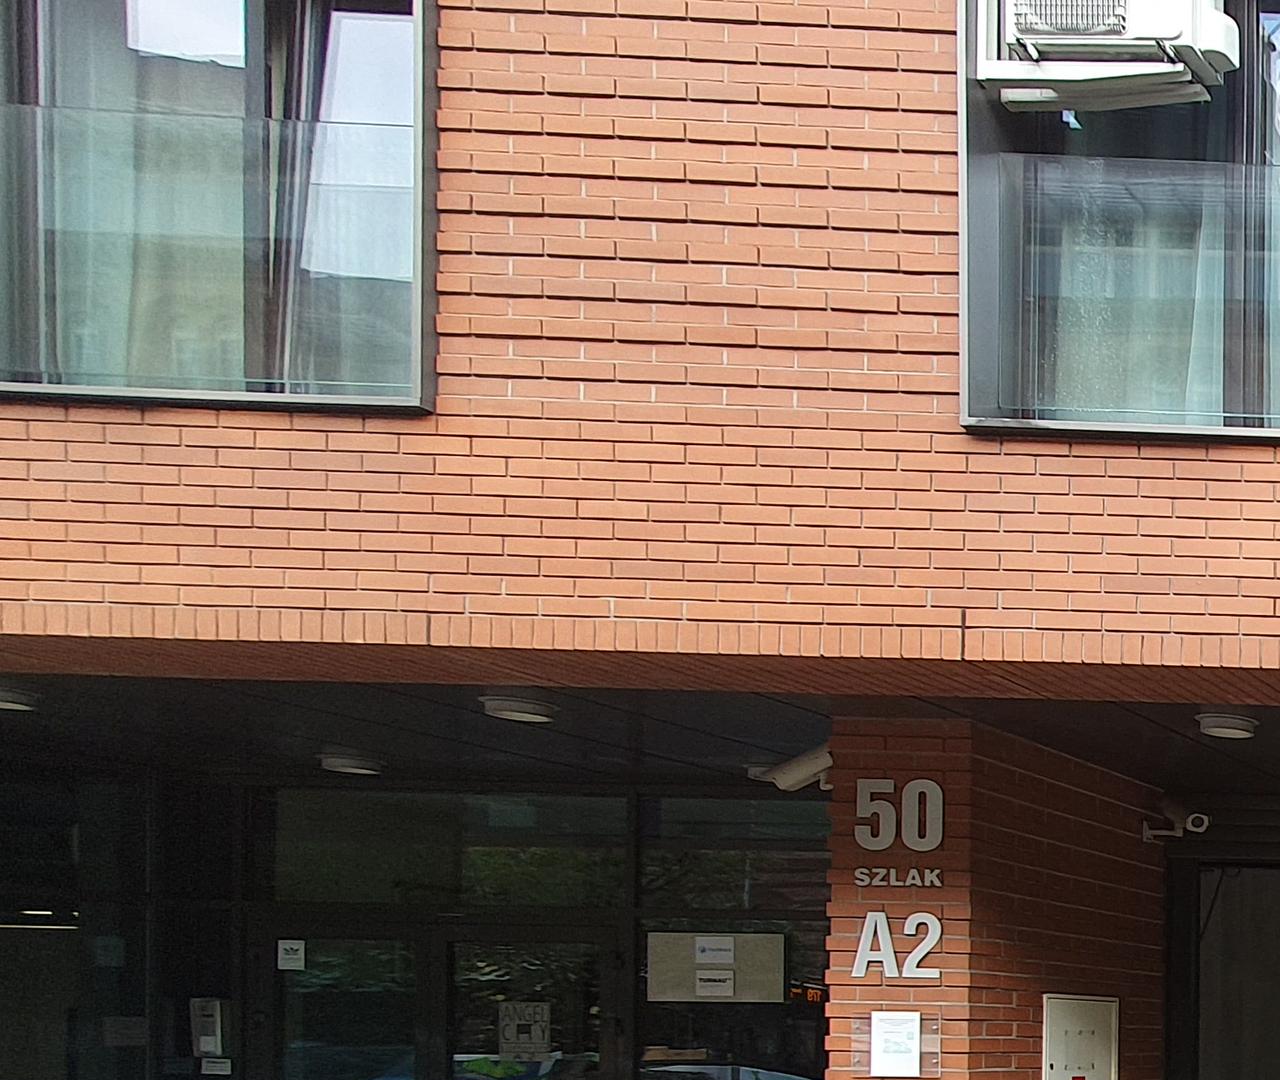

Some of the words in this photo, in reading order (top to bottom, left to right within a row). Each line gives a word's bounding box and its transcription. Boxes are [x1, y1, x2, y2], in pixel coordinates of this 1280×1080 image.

[854, 778, 944, 852] 50
[854, 867, 943, 887] SZLAK
[851, 912, 942, 978] A2
[502, 1004, 548, 1022] ANGEL
